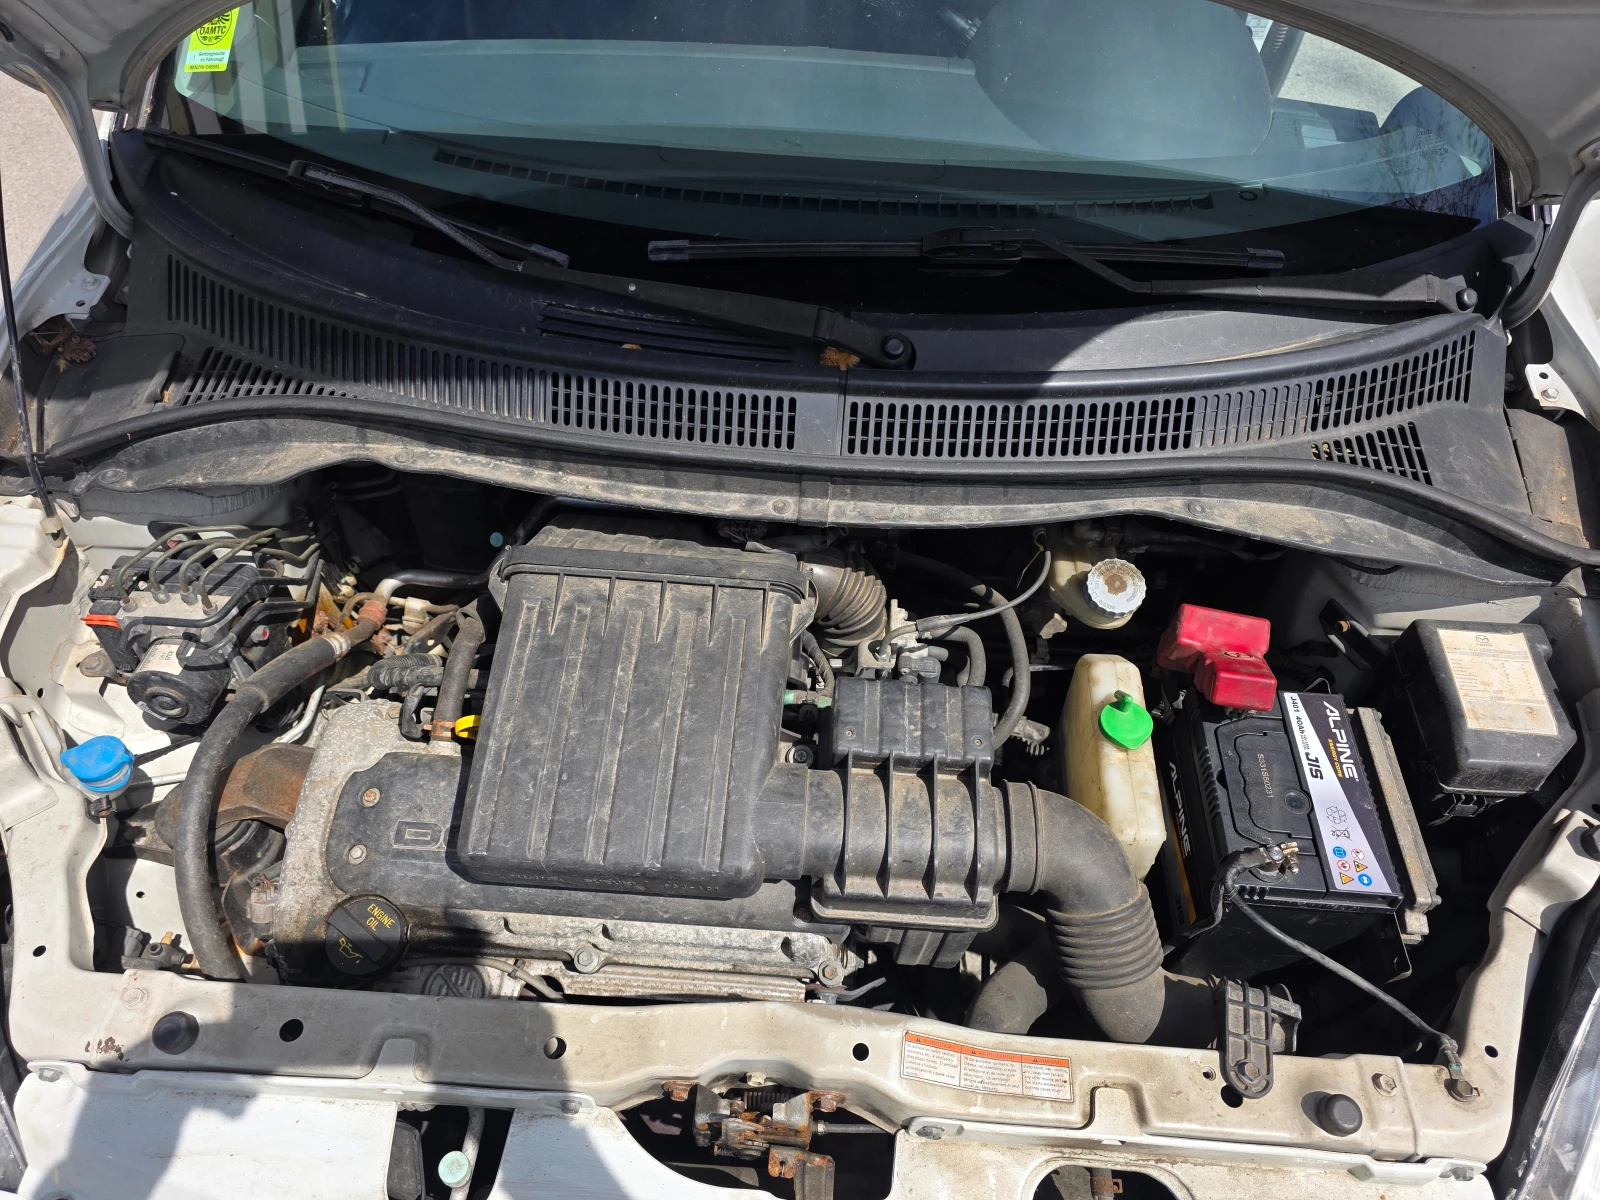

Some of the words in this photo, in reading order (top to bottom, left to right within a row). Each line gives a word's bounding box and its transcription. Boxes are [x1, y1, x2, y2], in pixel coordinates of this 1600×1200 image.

[1290, 696, 1301, 713] J401
[1295, 715, 1306, 735] 40Ah
[1323, 700, 1359, 780] ALPINE
[1305, 751, 1324, 780] JIS
[1168, 761, 1191, 857] ALPINE
[366, 903, 396, 929] ENGINE
[366, 917, 380, 932] OIL
